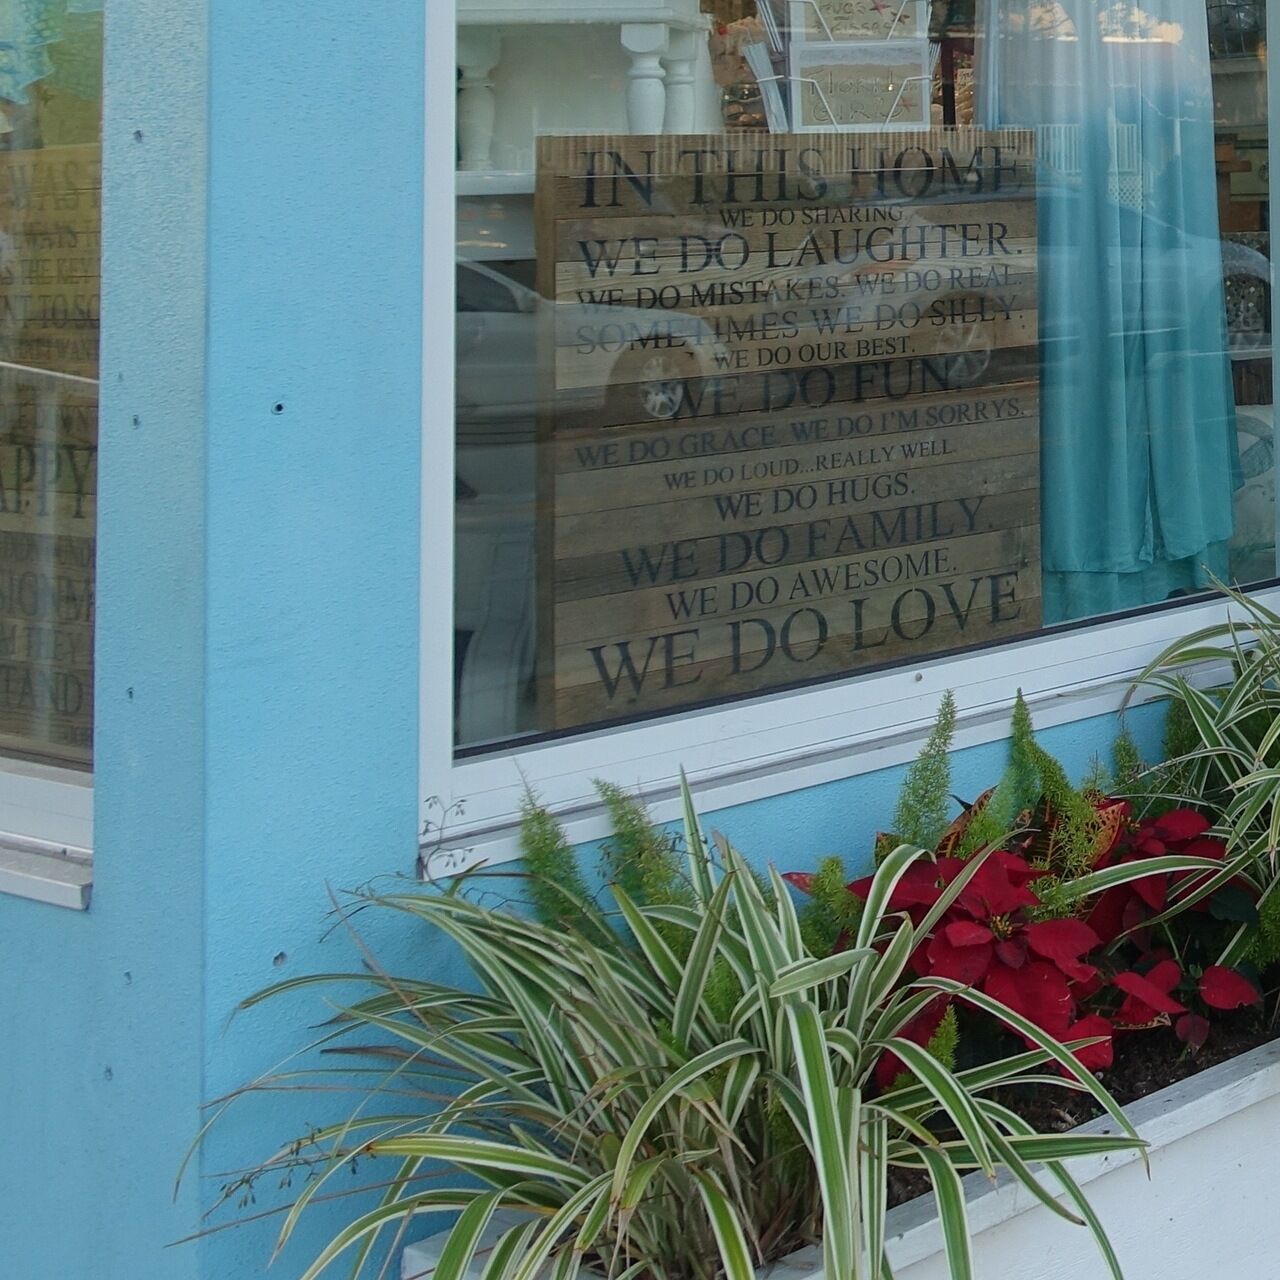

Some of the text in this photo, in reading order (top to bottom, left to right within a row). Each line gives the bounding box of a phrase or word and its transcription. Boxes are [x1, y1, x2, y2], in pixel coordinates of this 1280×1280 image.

[579, 144, 1021, 208] IN THIS HOME
[720, 208, 754, 228] WE
[761, 207, 796, 227] DO
[577, 222, 1023, 279] WE DO LAUGHTER.
[577, 264, 1023, 314] WE DO MISTAKES. WE DO REAL.
[577, 294, 1023, 356] SOMETIMES WE DO SILLY.
[714, 336, 915, 370] WE DO OUR BEST.
[668, 374, 743, 420] WE
[761, 366, 836, 414] DO
[575, 444, 619, 468] WE
[628, 437, 671, 463] DO
[790, 421, 831, 442] WE
[836, 415, 874, 439] DO
[881, 410, 919, 433] I'M
[926, 397, 1024, 427] SORRYS.
[664, 471, 697, 491] WE
[703, 465, 735, 486] DO
[715, 471, 915, 521] WE DO HUGS.
[620, 498, 994, 588] WE DO FAMILY.
[666, 547, 958, 620] WE DO AWESOME.
[585, 571, 1023, 701] WE DO LOVE
